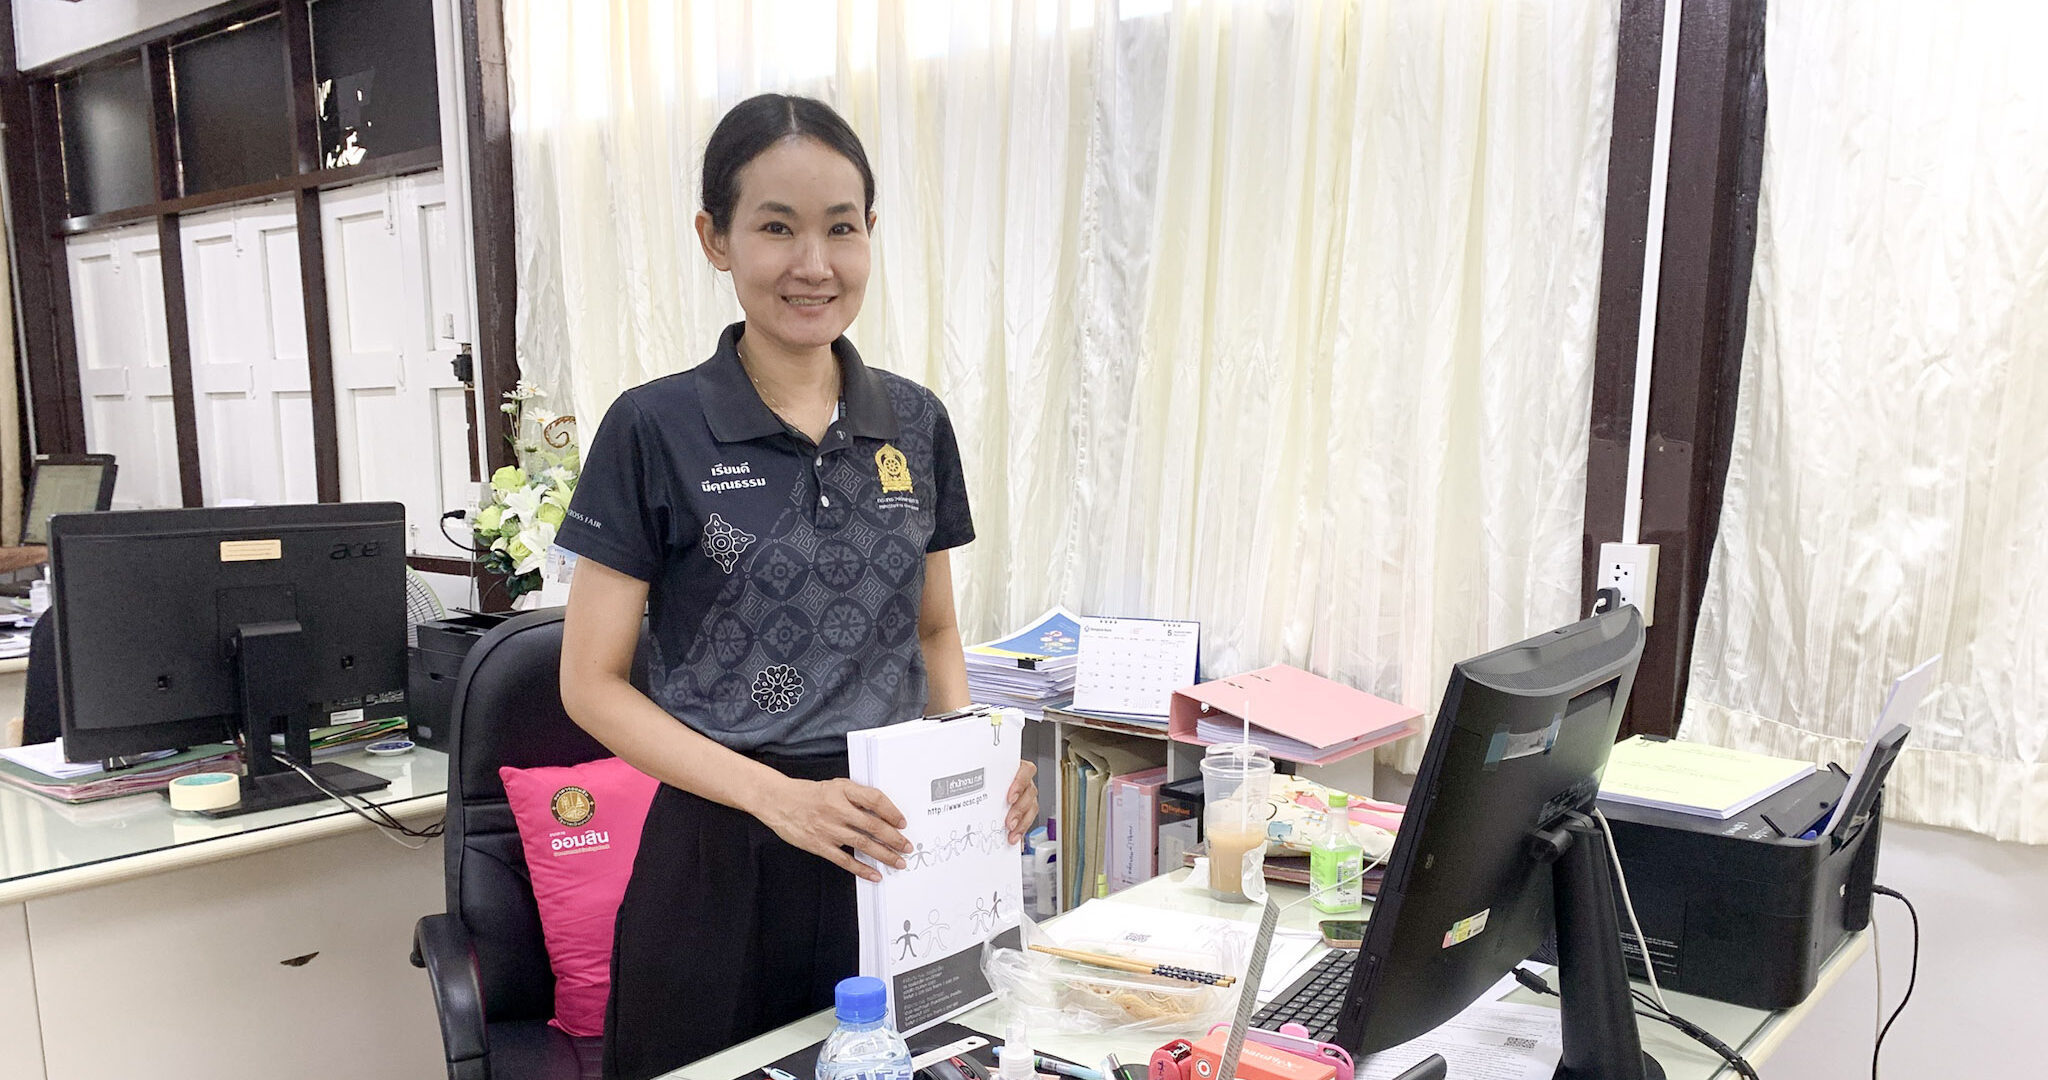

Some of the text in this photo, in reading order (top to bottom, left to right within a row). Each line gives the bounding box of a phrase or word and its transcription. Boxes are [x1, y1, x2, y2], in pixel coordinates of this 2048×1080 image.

[711, 462, 751, 476] เรียนดี
[701, 478, 767, 494] มีคุณธรรม
[1167, 629, 1173, 637] 5
[551, 829, 609, 851] ออมสิน
